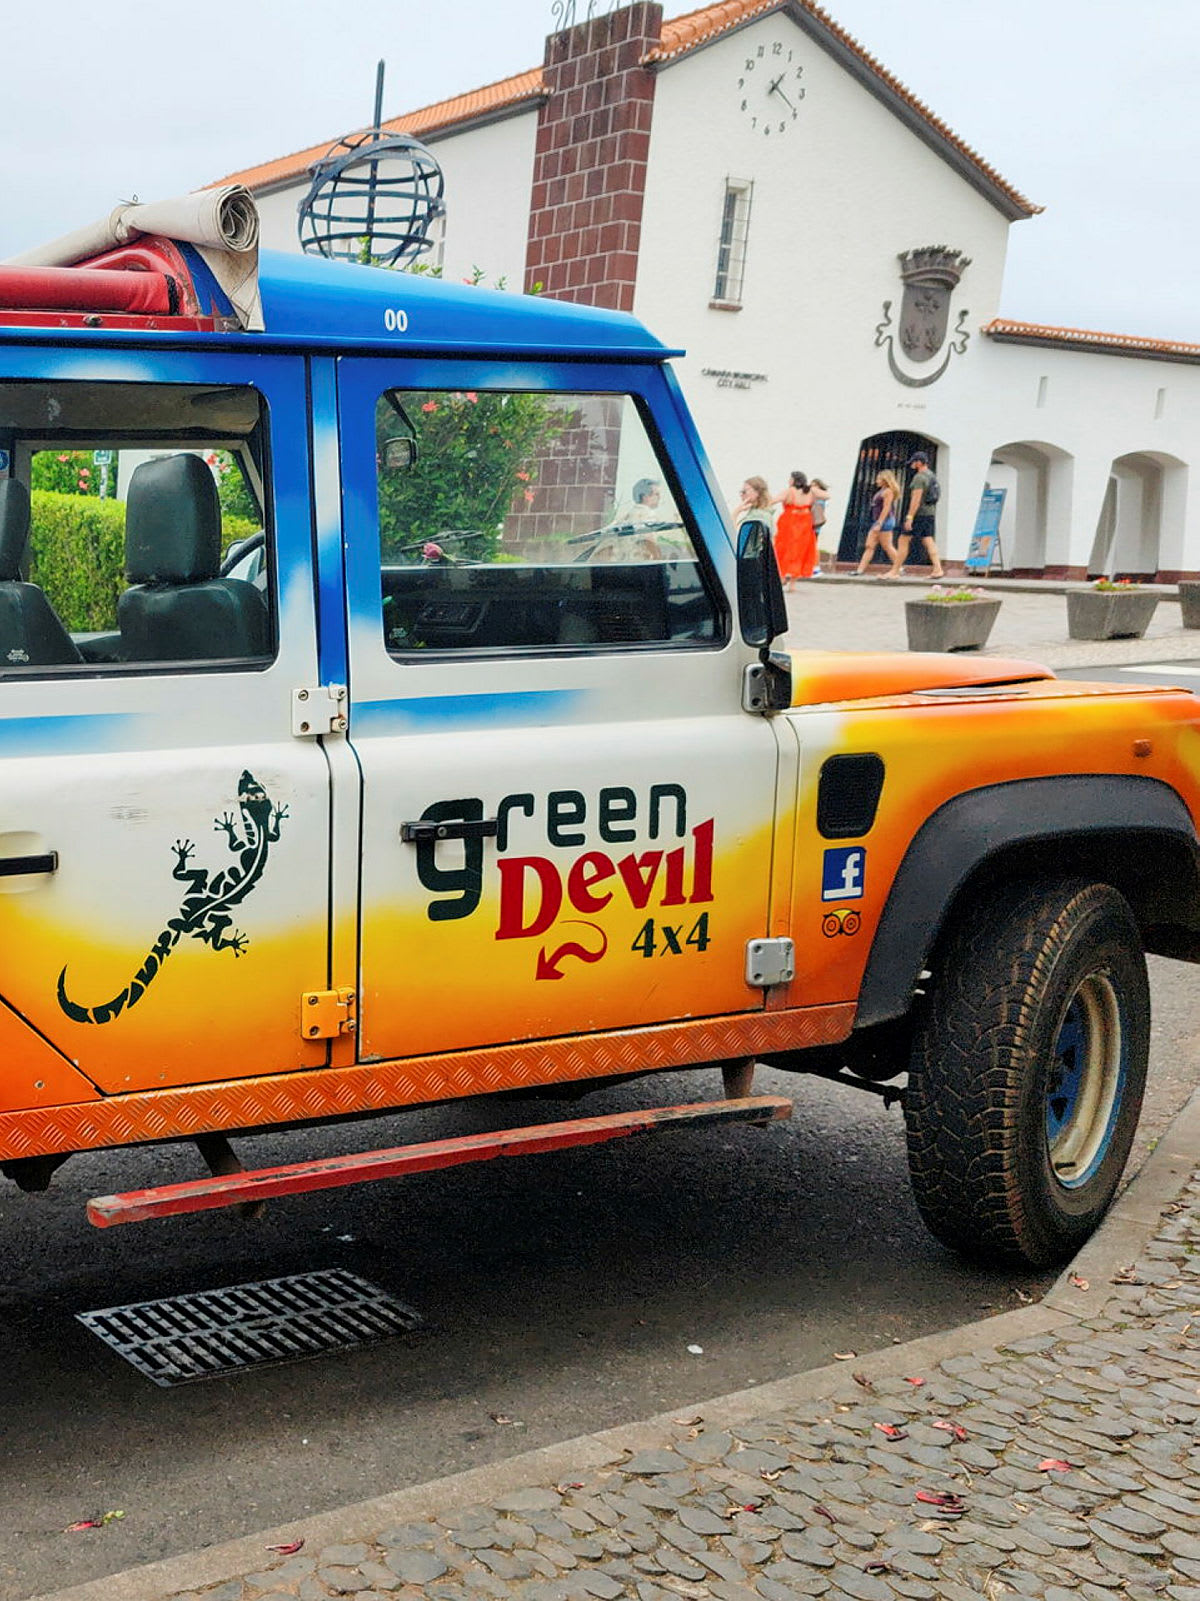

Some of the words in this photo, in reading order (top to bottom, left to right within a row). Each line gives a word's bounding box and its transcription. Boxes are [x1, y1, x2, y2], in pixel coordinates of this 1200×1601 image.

[772, 41, 783, 55] 12
[745, 59, 755, 71] 10
[796, 66, 804, 79] 2
[799, 88, 806, 100] 3
[752, 116, 757, 130] 7
[779, 121, 786, 133] 5
[384, 308, 409, 333] 00
[416, 782, 687, 922] green
[495, 818, 715, 941] Devil
[631, 911, 711, 959] 4x4
